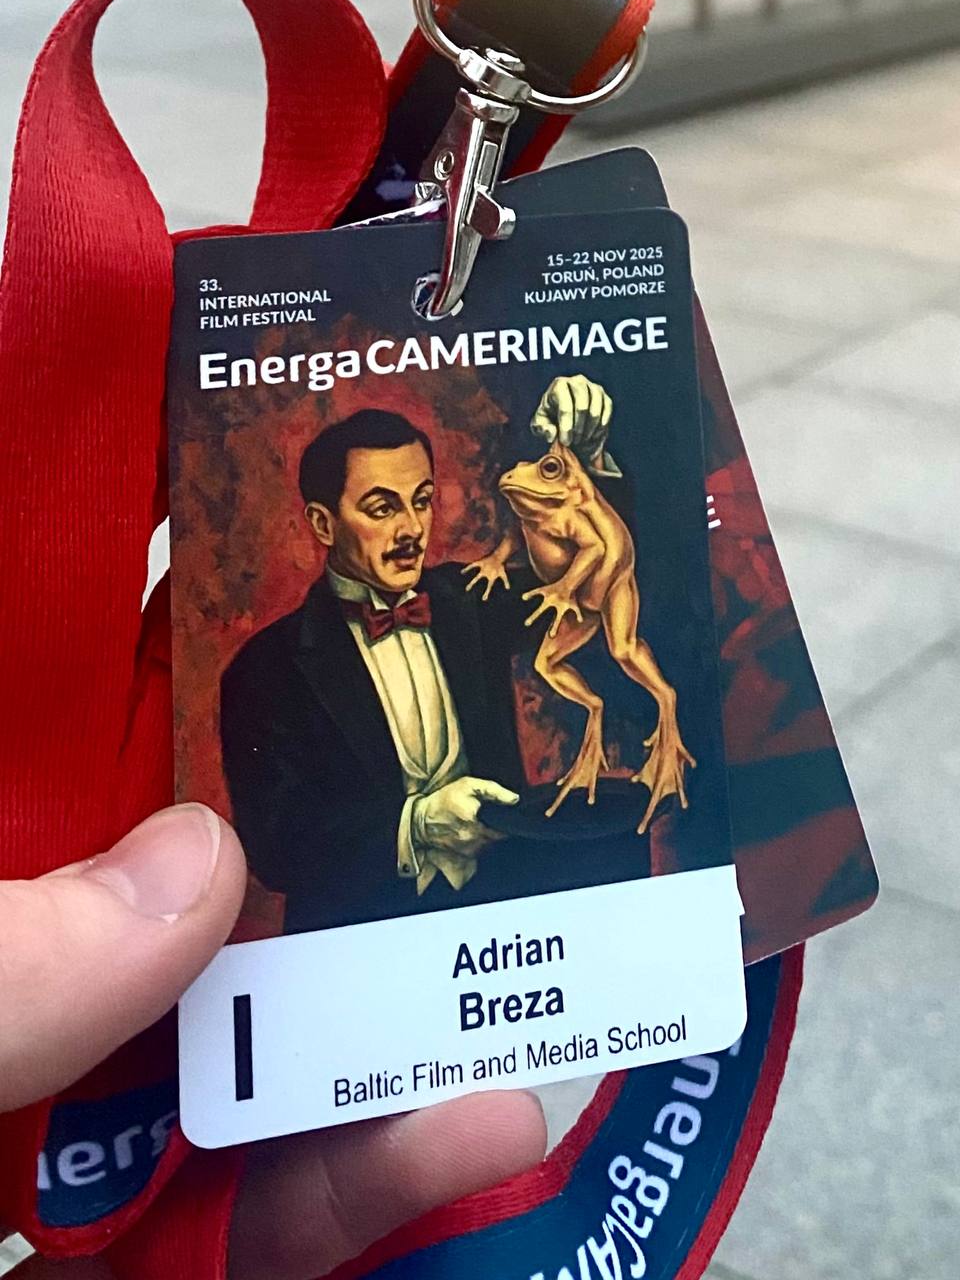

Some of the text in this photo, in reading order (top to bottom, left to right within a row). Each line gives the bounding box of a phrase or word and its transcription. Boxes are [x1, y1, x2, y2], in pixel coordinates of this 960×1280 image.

[593, 248, 627, 263] NOV
[629, 246, 663, 260] 2025
[199, 278, 223, 292] 33.
[542, 263, 665, 286] TORUŃ, POLAND
[199, 289, 332, 311] INTERNATIONAL
[524, 280, 666, 304] KUJAWY POMORZE
[200, 308, 317, 330] FILM FESTIVAL
[452, 933, 565, 979] Adrian
[459, 986, 565, 1032] Breza
[334, 1014, 688, 1108] Baltic Film and Media School
